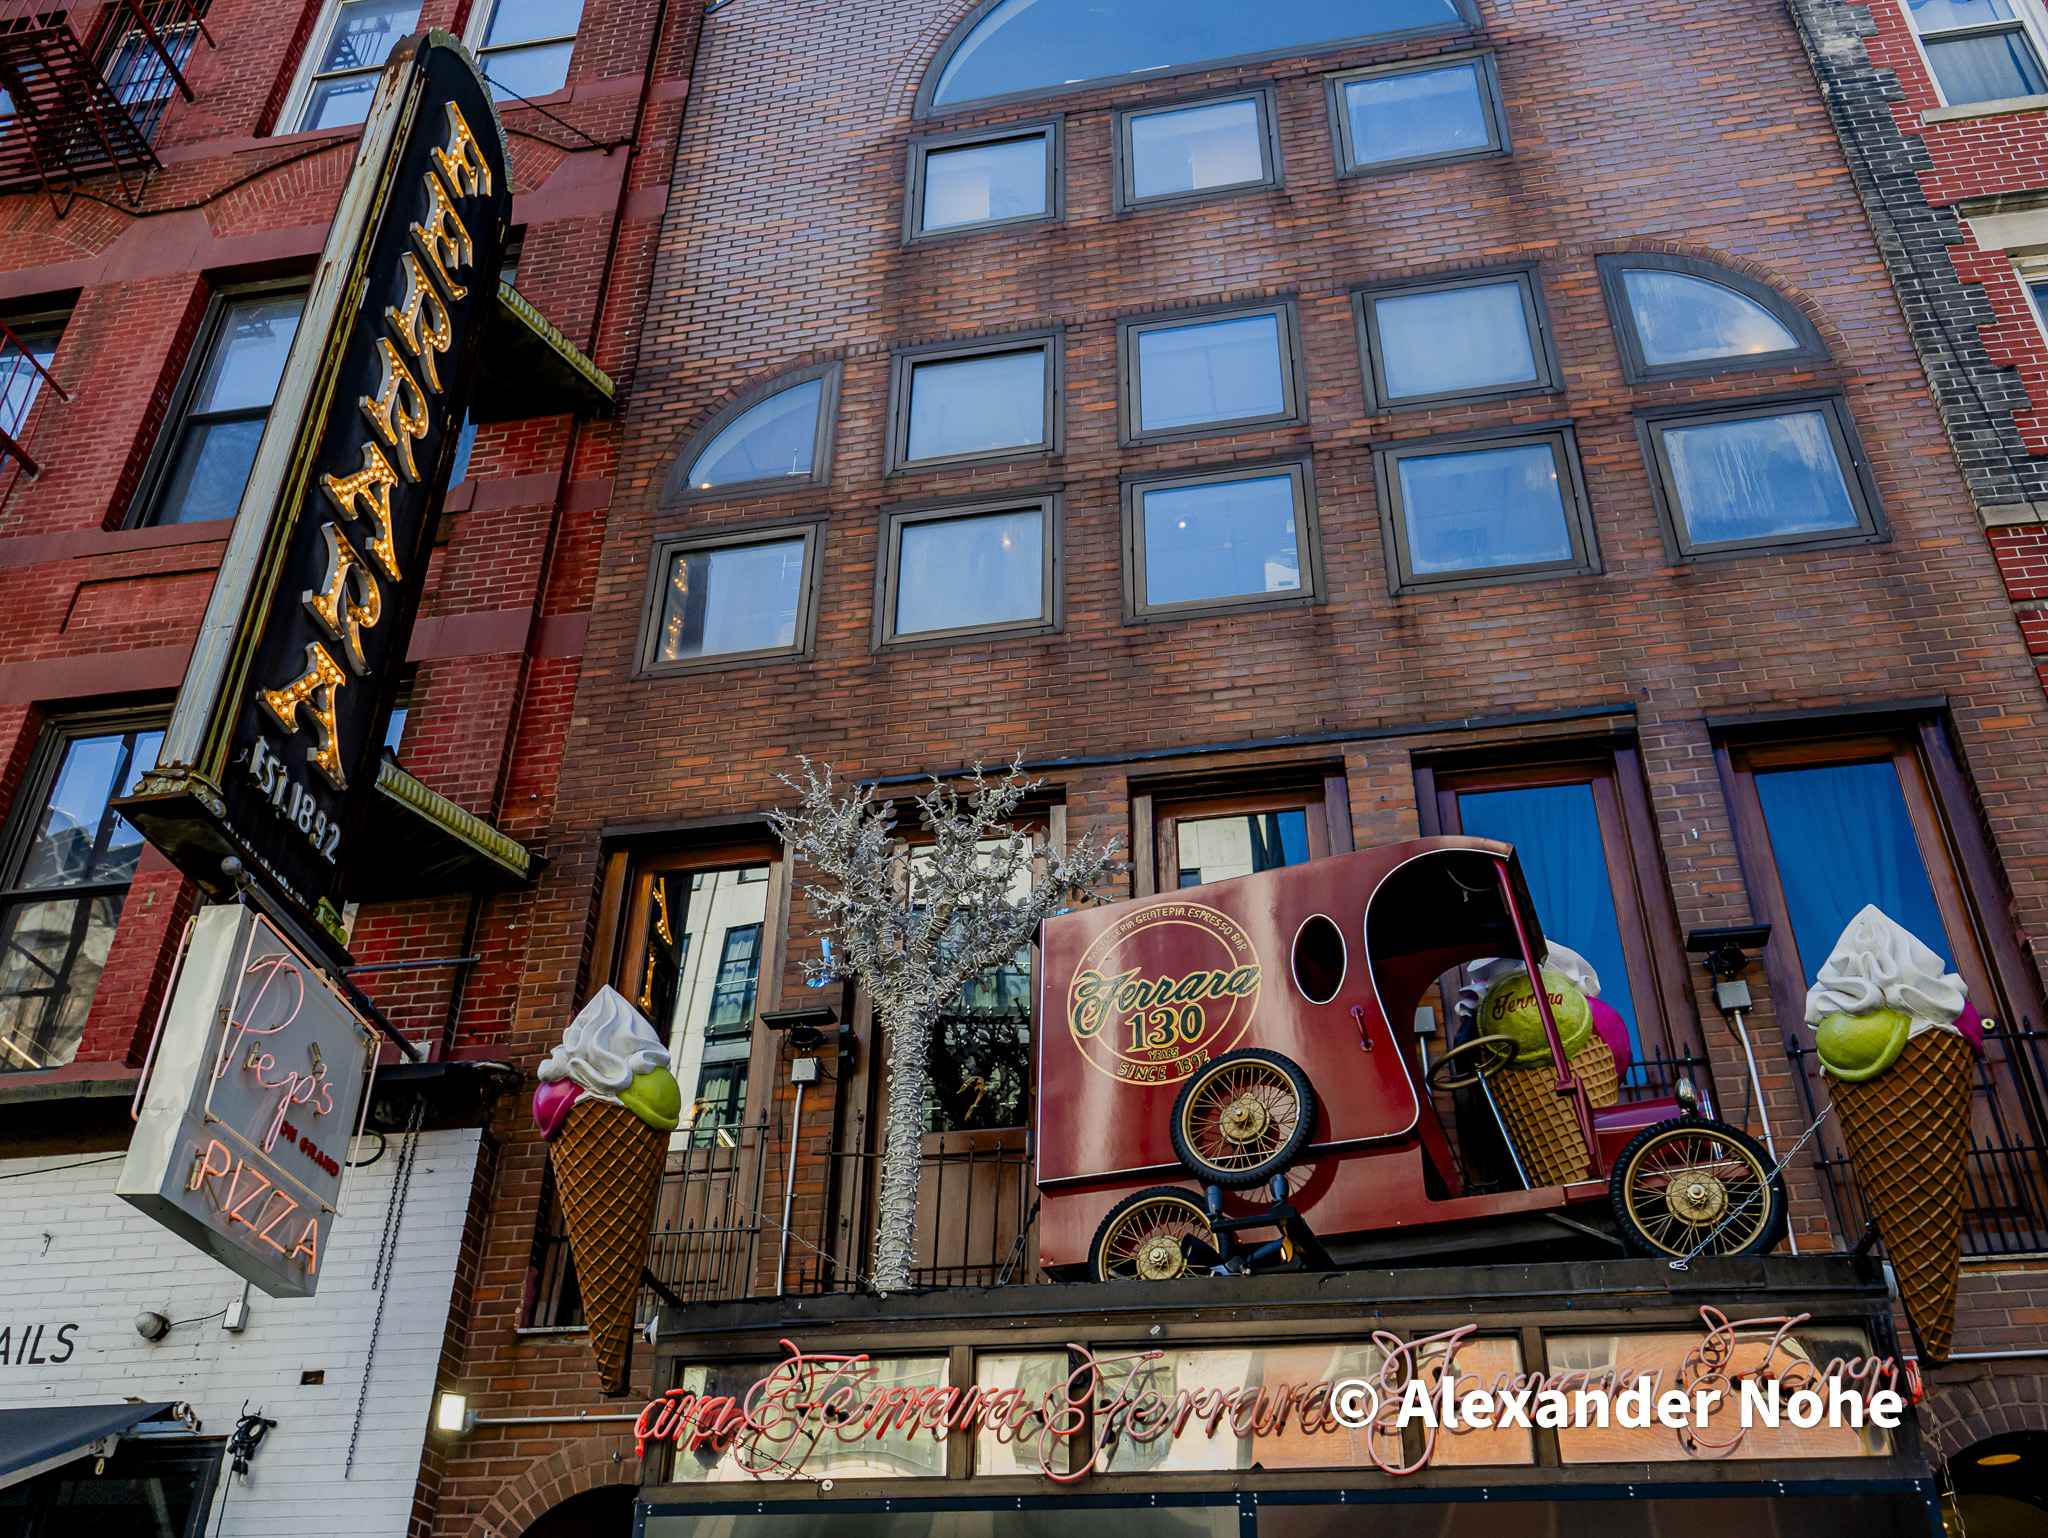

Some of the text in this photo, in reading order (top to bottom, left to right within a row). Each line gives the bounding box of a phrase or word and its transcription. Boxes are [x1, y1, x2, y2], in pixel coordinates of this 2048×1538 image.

[256, 100, 491, 791] FERRARA
[1231, 933, 1247, 953] BAR
[1073, 965, 1262, 1038] Ferrara
[1125, 1003, 1205, 1052] 130
[1492, 991, 1564, 1021] Ferrra
[216, 954, 333, 1153] Pep's
[1118, 1049, 1210, 1082] SINCE 1892
[1148, 1047, 1179, 1061] YEARS
[280, 1120, 340, 1177] ON GRAND
[196, 1139, 318, 1276] PIZZA
[732, 1338, 1035, 1474] Ferrara
[1037, 1342, 1343, 1482] Ferrara
